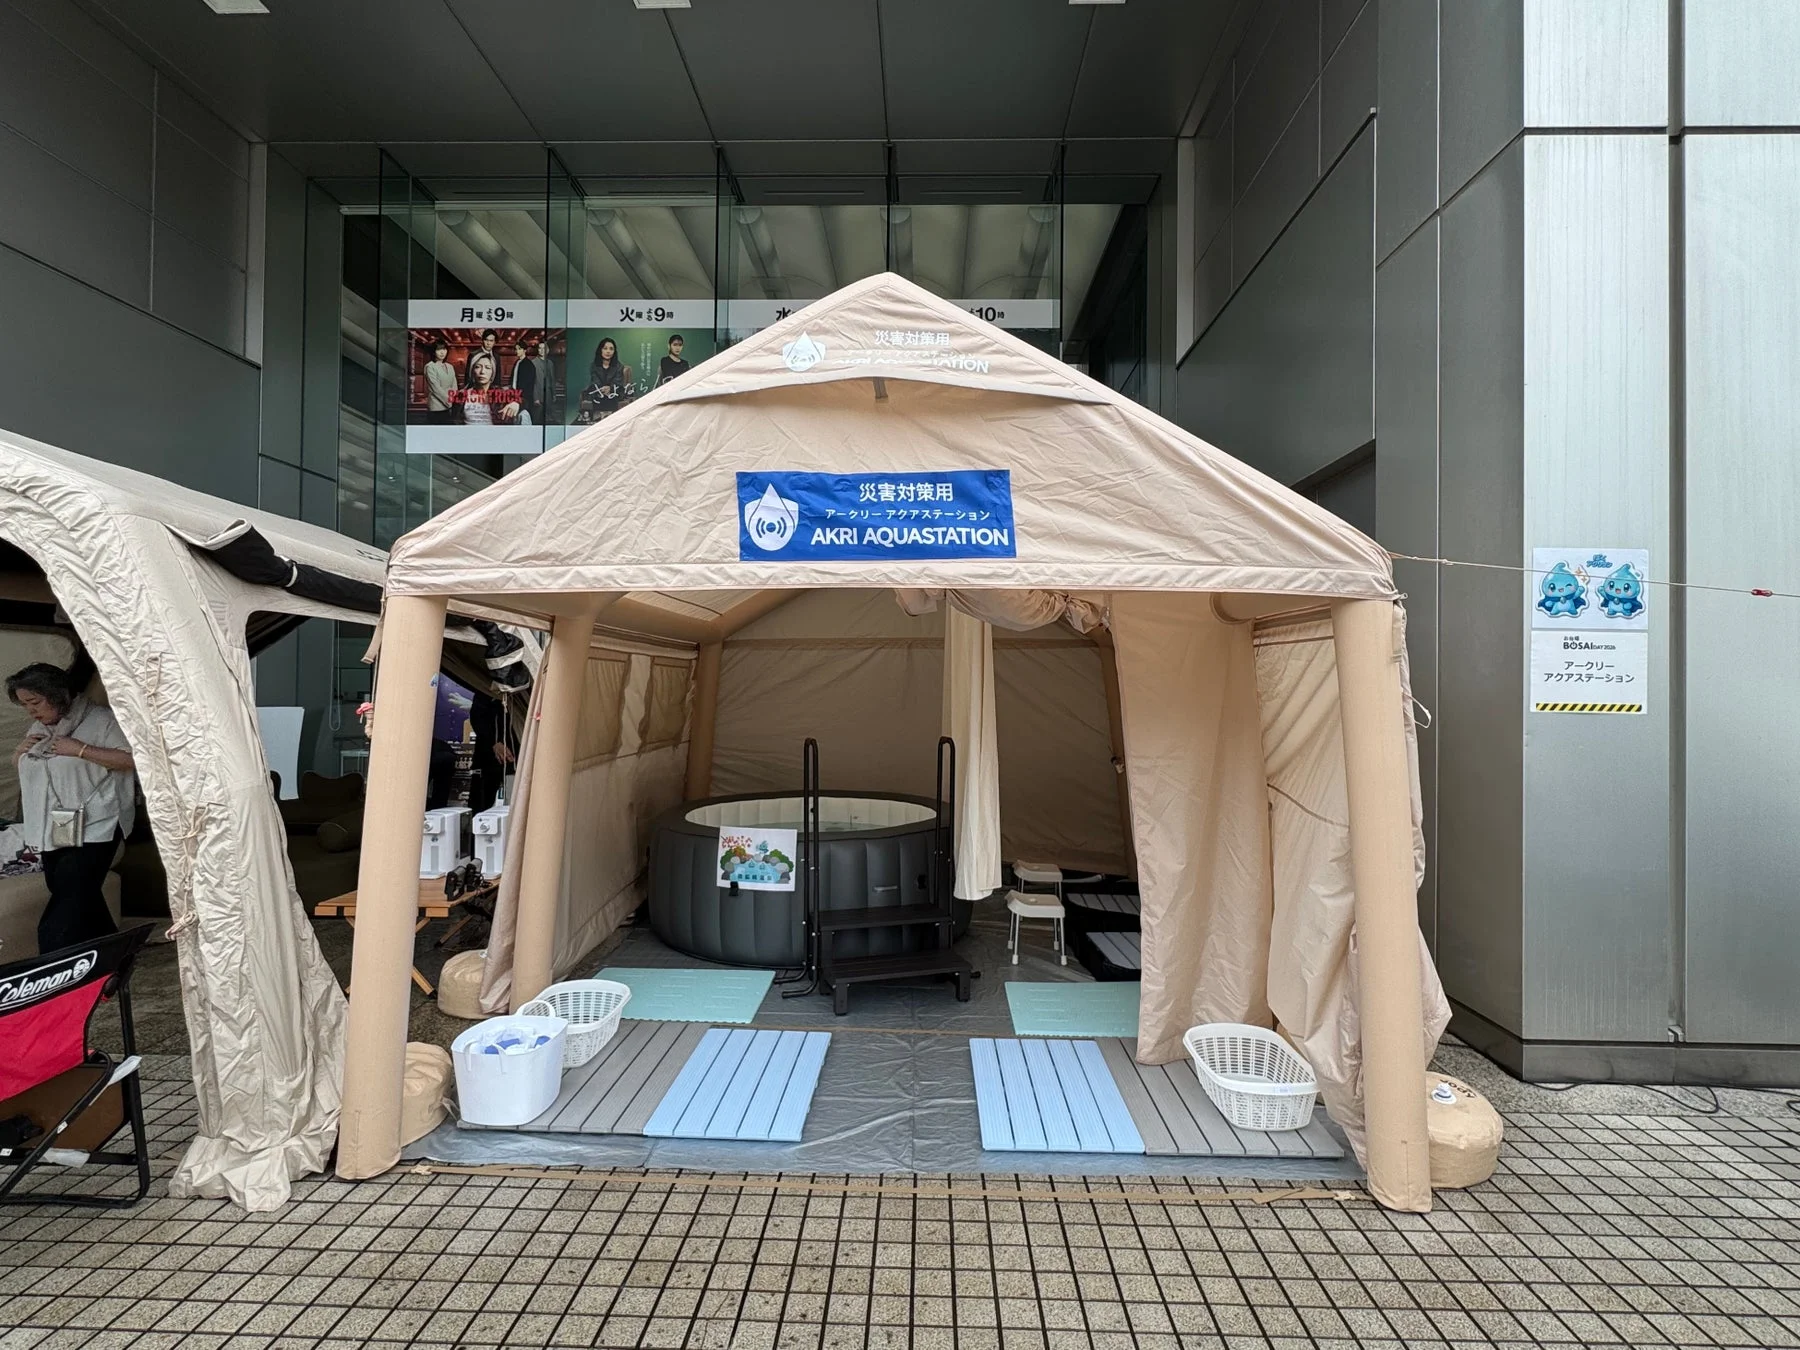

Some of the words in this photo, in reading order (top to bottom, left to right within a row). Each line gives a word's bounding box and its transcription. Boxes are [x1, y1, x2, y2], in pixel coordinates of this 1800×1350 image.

[875, 330, 950, 346] 災害対策用
[859, 482, 954, 502] 災害対策用
[825, 509, 881, 520] アークリー
[887, 508, 990, 521] アクアステーション
[811, 527, 858, 545] AKRI
[862, 526, 1009, 548] AQUASTATION
[1563, 641, 1593, 650] BOSAI
[1564, 661, 1615, 671] アークリー
[1544, 673, 1635, 683] アクアステーション
[0, 969, 72, 1002] Coleman
